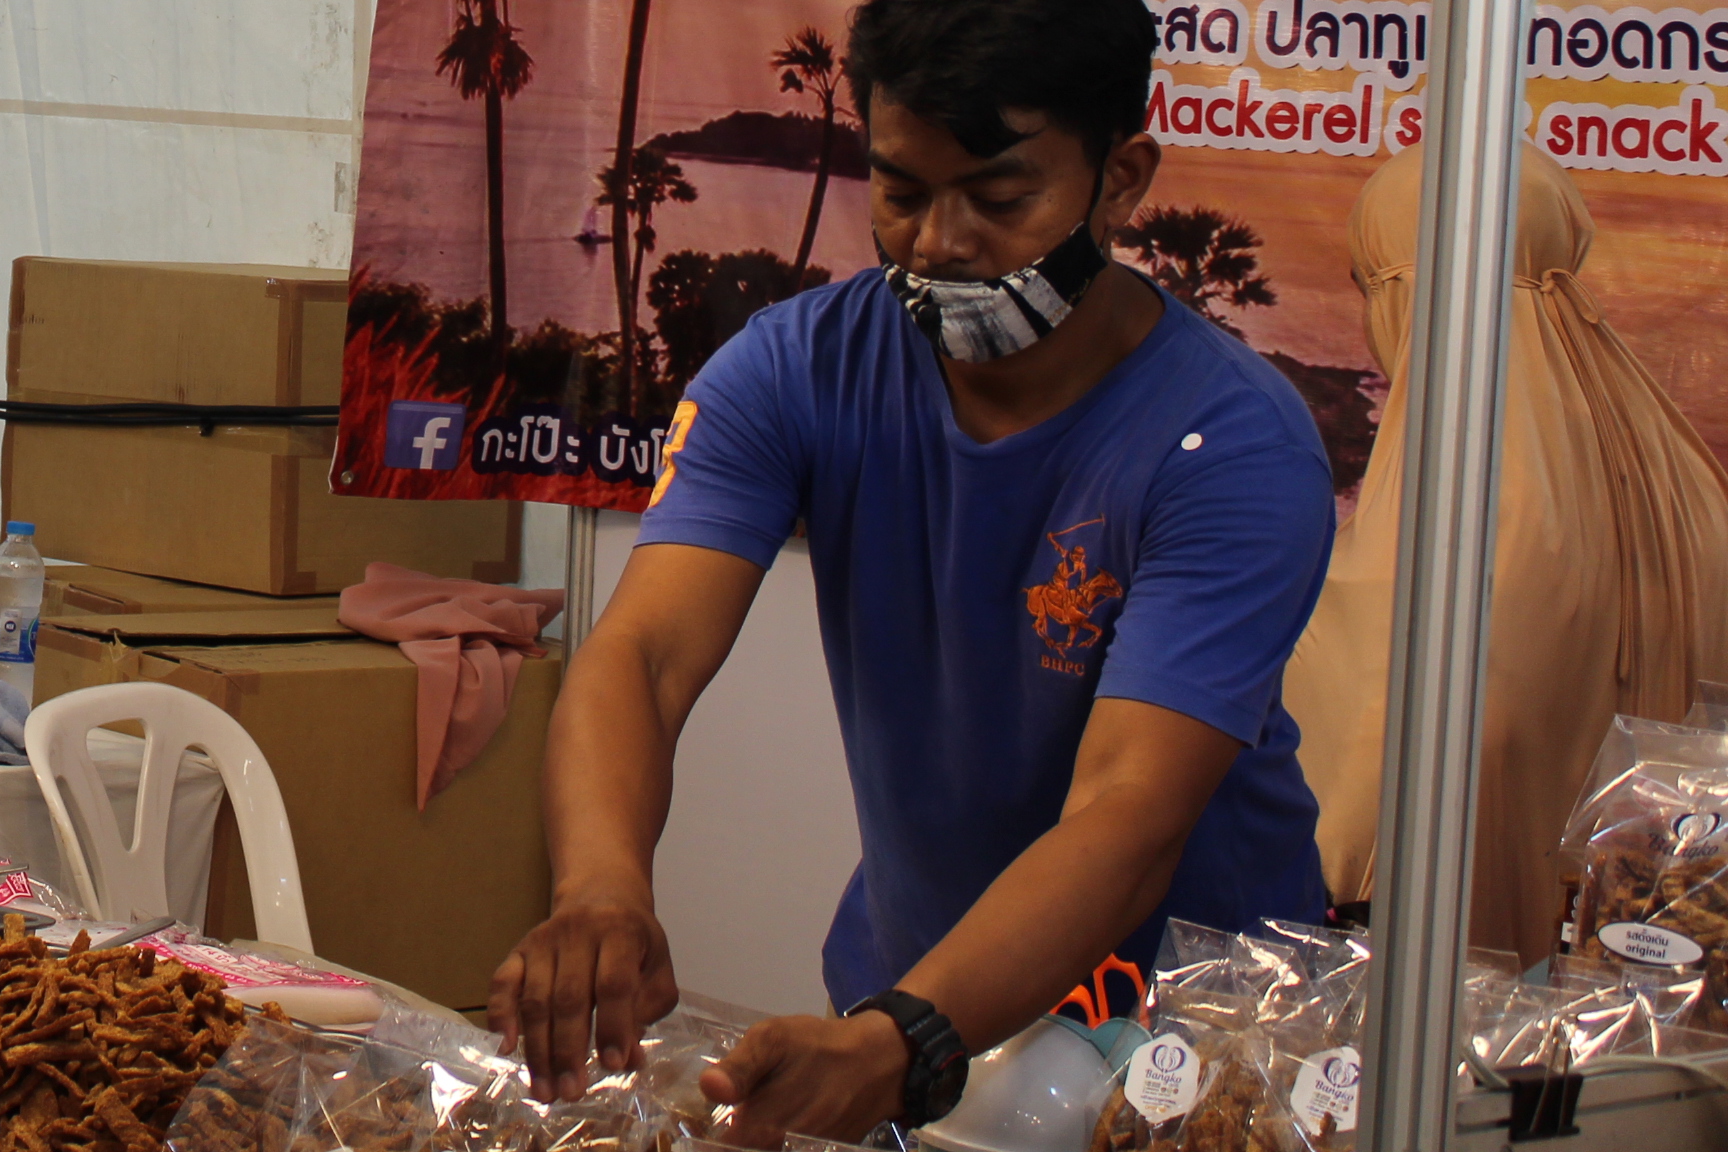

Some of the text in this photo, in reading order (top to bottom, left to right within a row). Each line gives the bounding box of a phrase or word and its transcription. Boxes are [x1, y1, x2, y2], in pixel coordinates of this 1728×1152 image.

[1546, 98, 1723, 164] snack
[1625, 944, 1667, 960] original
[1144, 1068, 1183, 1085] Bangko
[1315, 1078, 1355, 1104] Bangko
